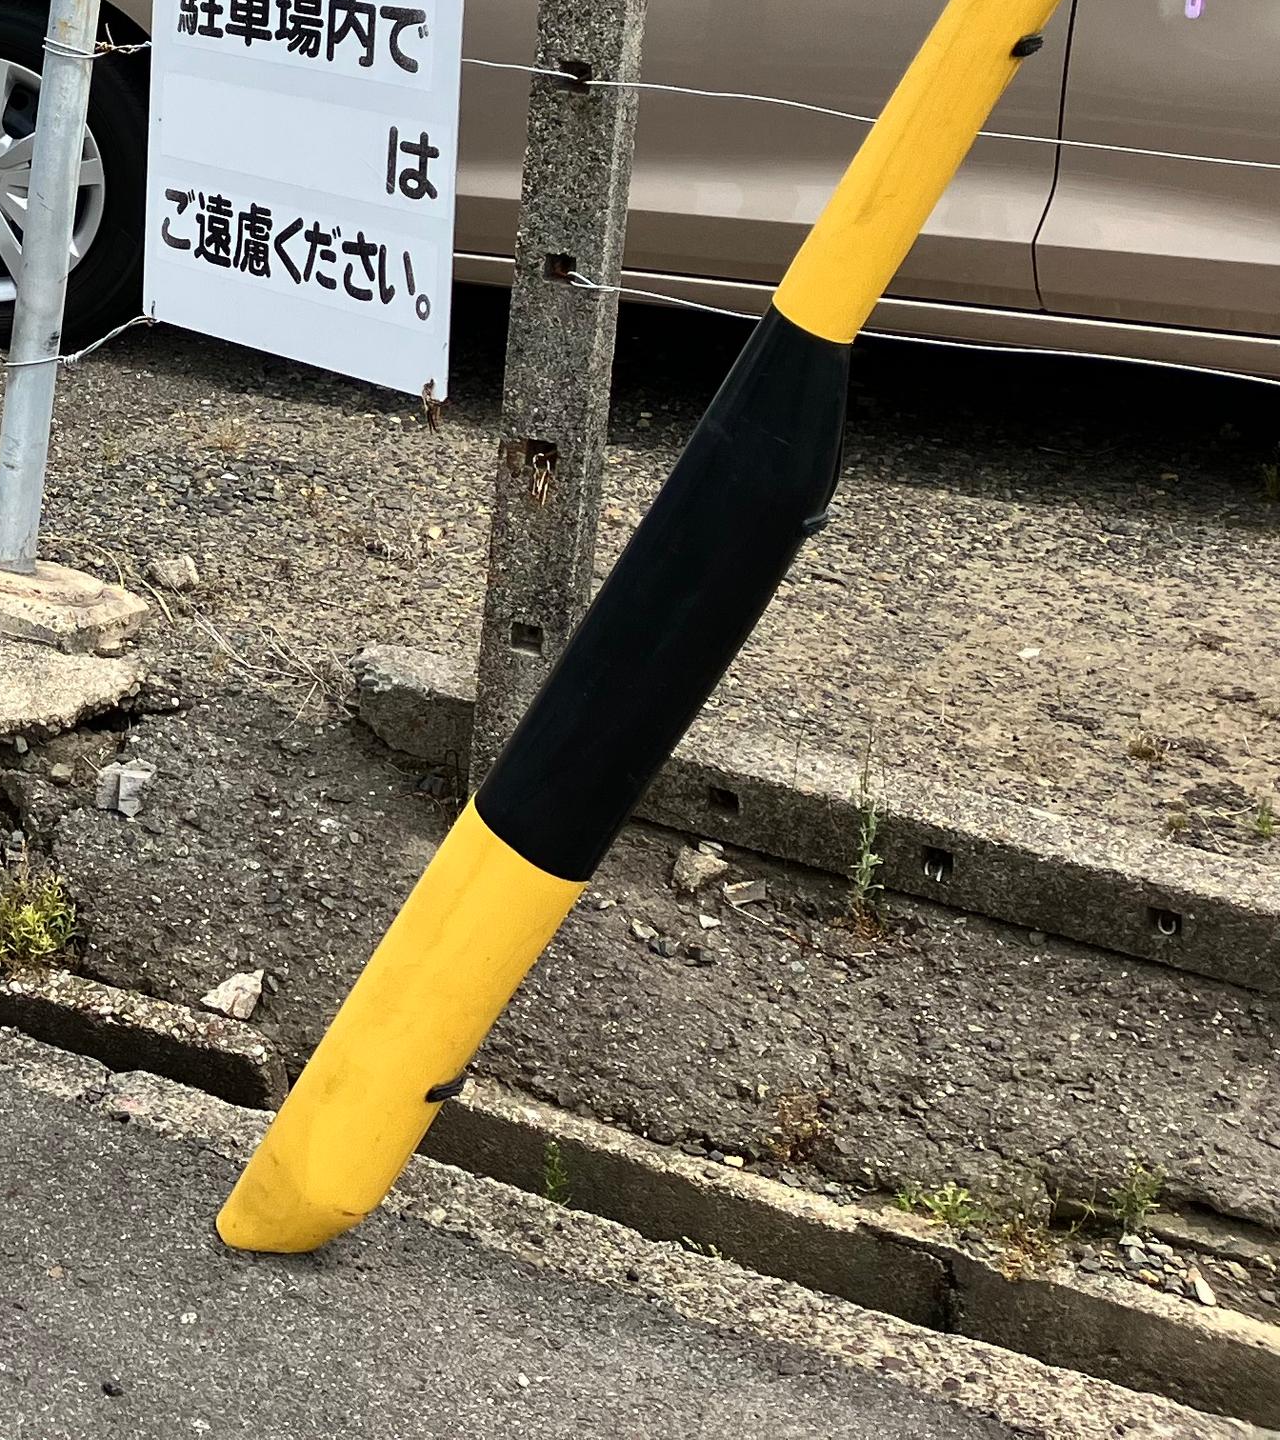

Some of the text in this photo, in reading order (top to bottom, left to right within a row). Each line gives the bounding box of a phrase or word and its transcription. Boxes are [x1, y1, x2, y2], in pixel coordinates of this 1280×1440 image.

[385, 126, 441, 201] は
[160, 188, 433, 322] ご遠慮ください。
